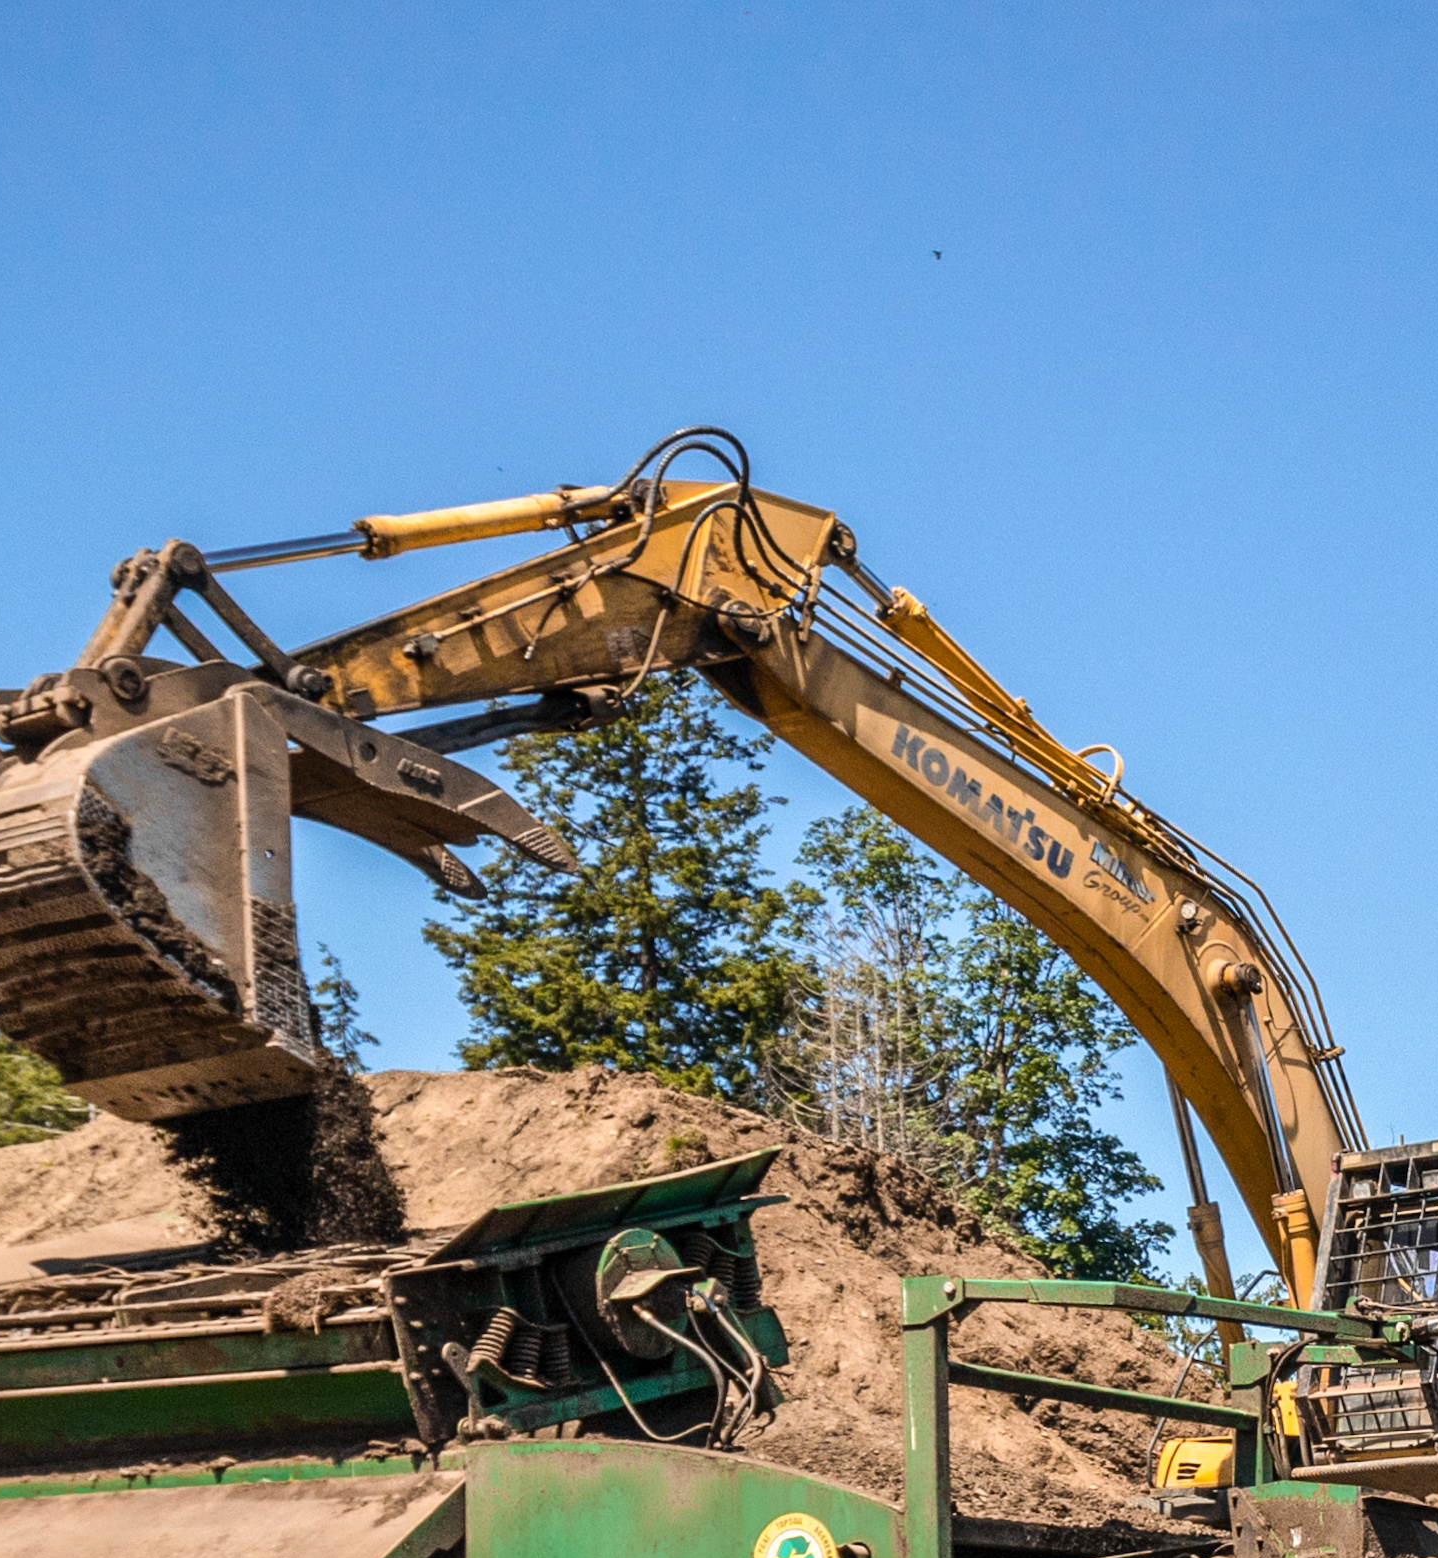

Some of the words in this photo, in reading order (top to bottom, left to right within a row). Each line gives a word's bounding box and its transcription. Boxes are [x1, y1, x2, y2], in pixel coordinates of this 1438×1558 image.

[890, 723, 1075, 880] KOMATSU
[1083, 870, 1141, 914] Group
[775, 1517, 803, 1530] TOPSOIL
